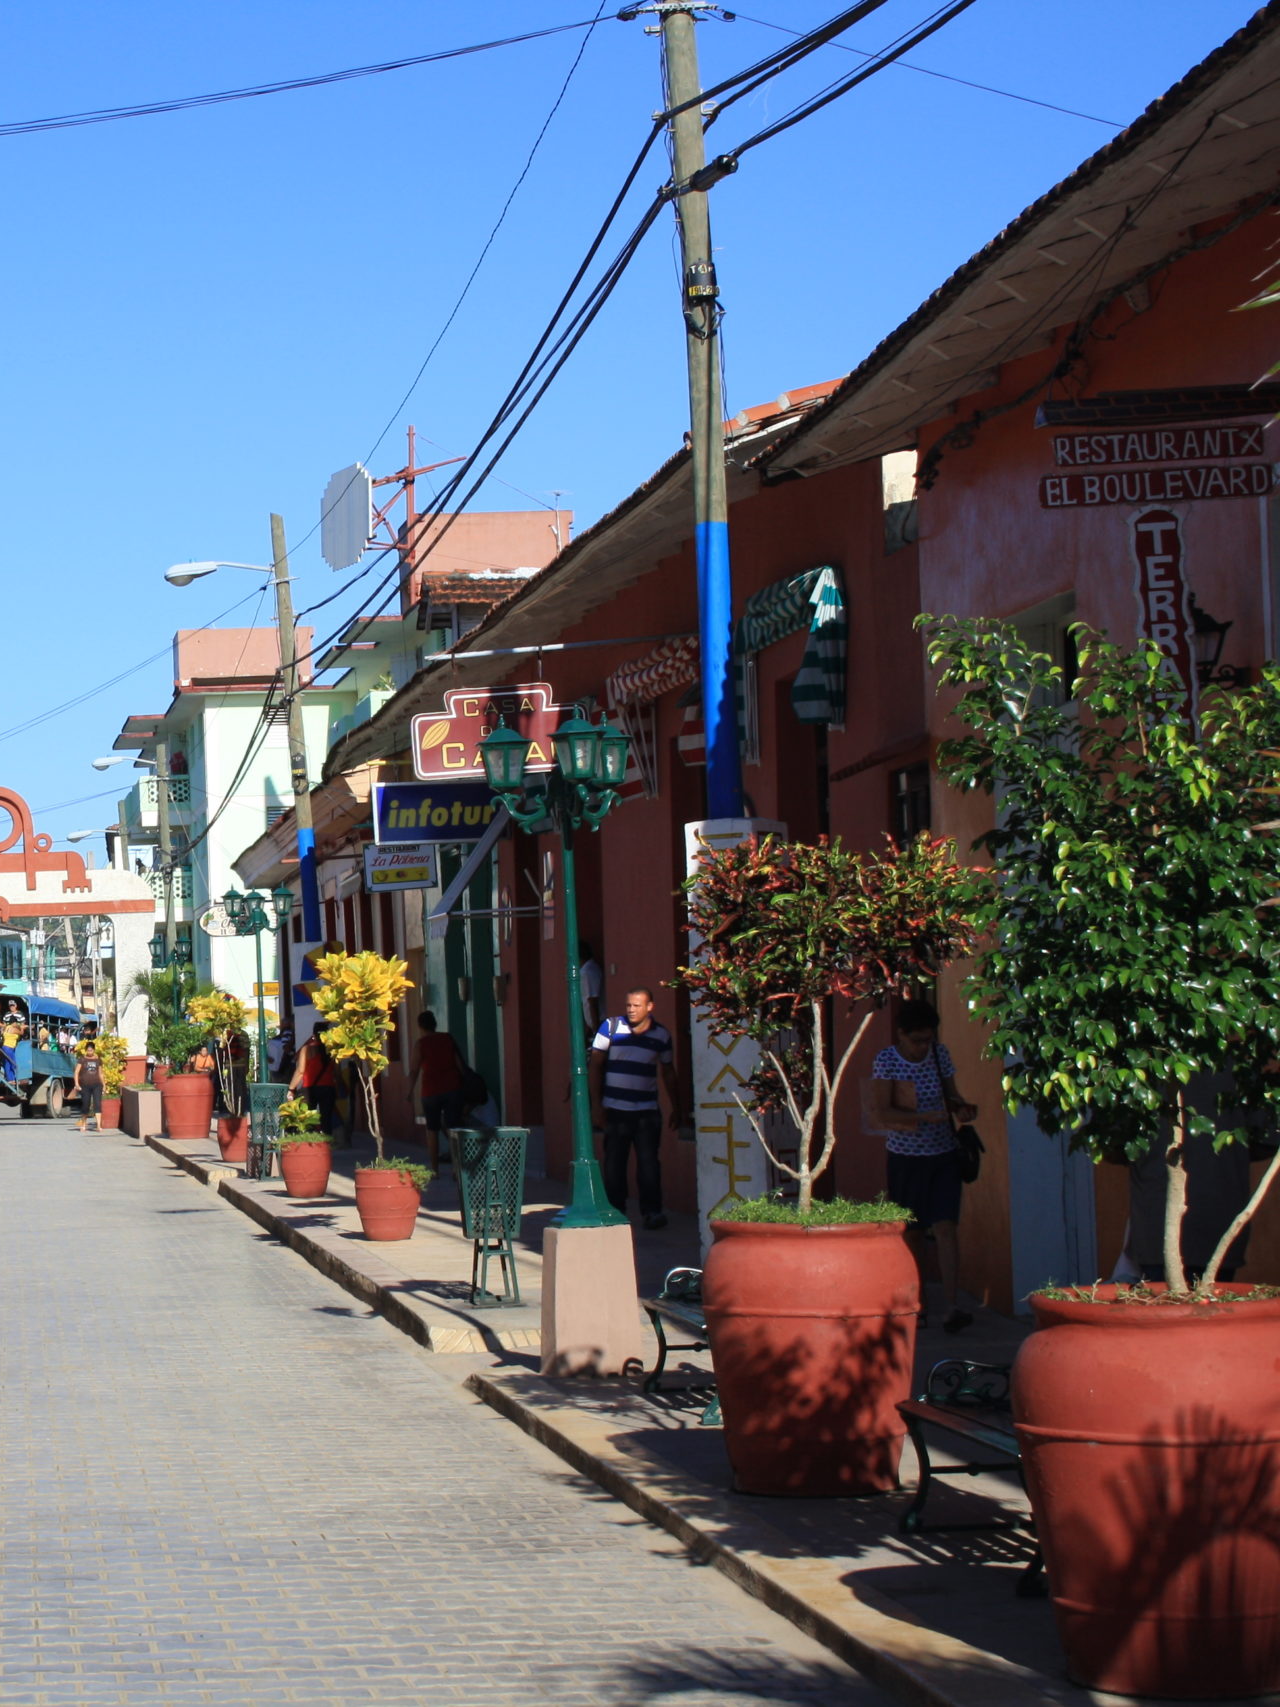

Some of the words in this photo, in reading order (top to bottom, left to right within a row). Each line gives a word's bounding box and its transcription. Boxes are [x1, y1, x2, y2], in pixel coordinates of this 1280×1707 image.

[1046, 477, 1077, 506] EL
[1083, 465, 1269, 504] BOULEVARD
[463, 697, 535, 718] CASA
[388, 797, 495, 829] infotur
